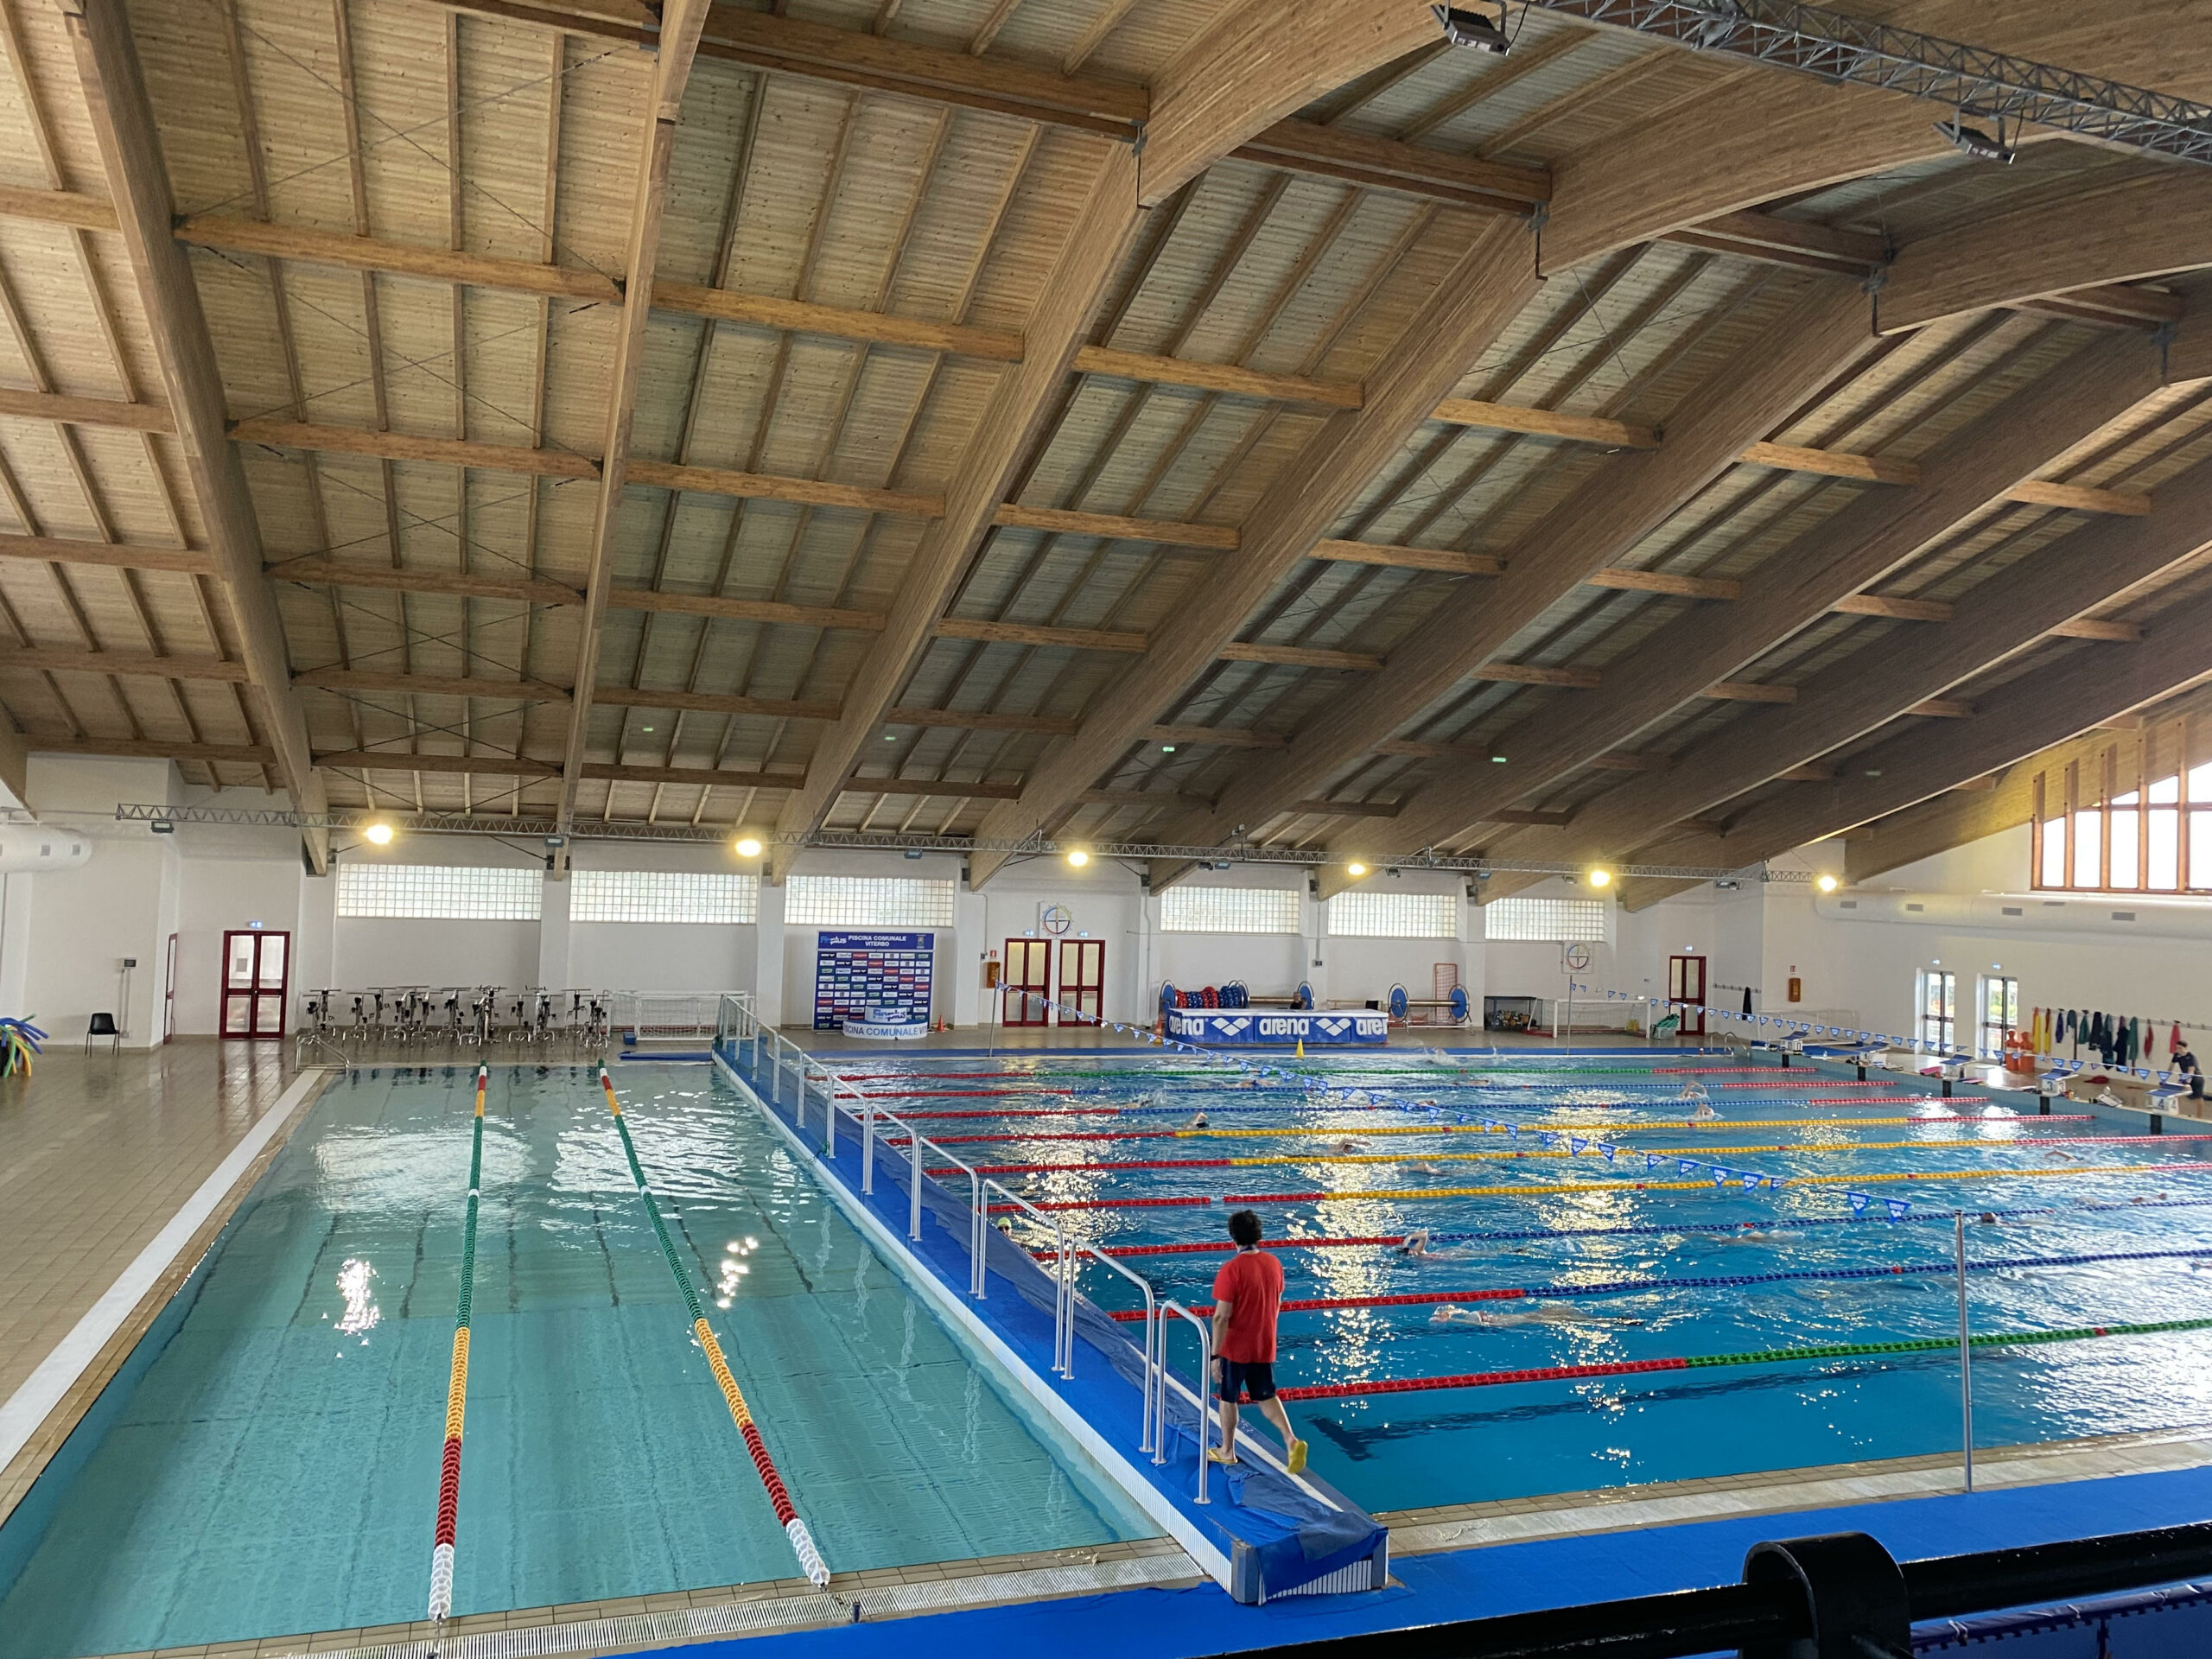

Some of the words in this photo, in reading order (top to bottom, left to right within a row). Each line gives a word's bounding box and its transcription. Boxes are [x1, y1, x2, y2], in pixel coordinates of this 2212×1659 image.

[866, 1027, 918, 1037] COMUNALE
[1259, 1018, 1310, 1035] arena
[2158, 1098, 2164, 1109] 4
